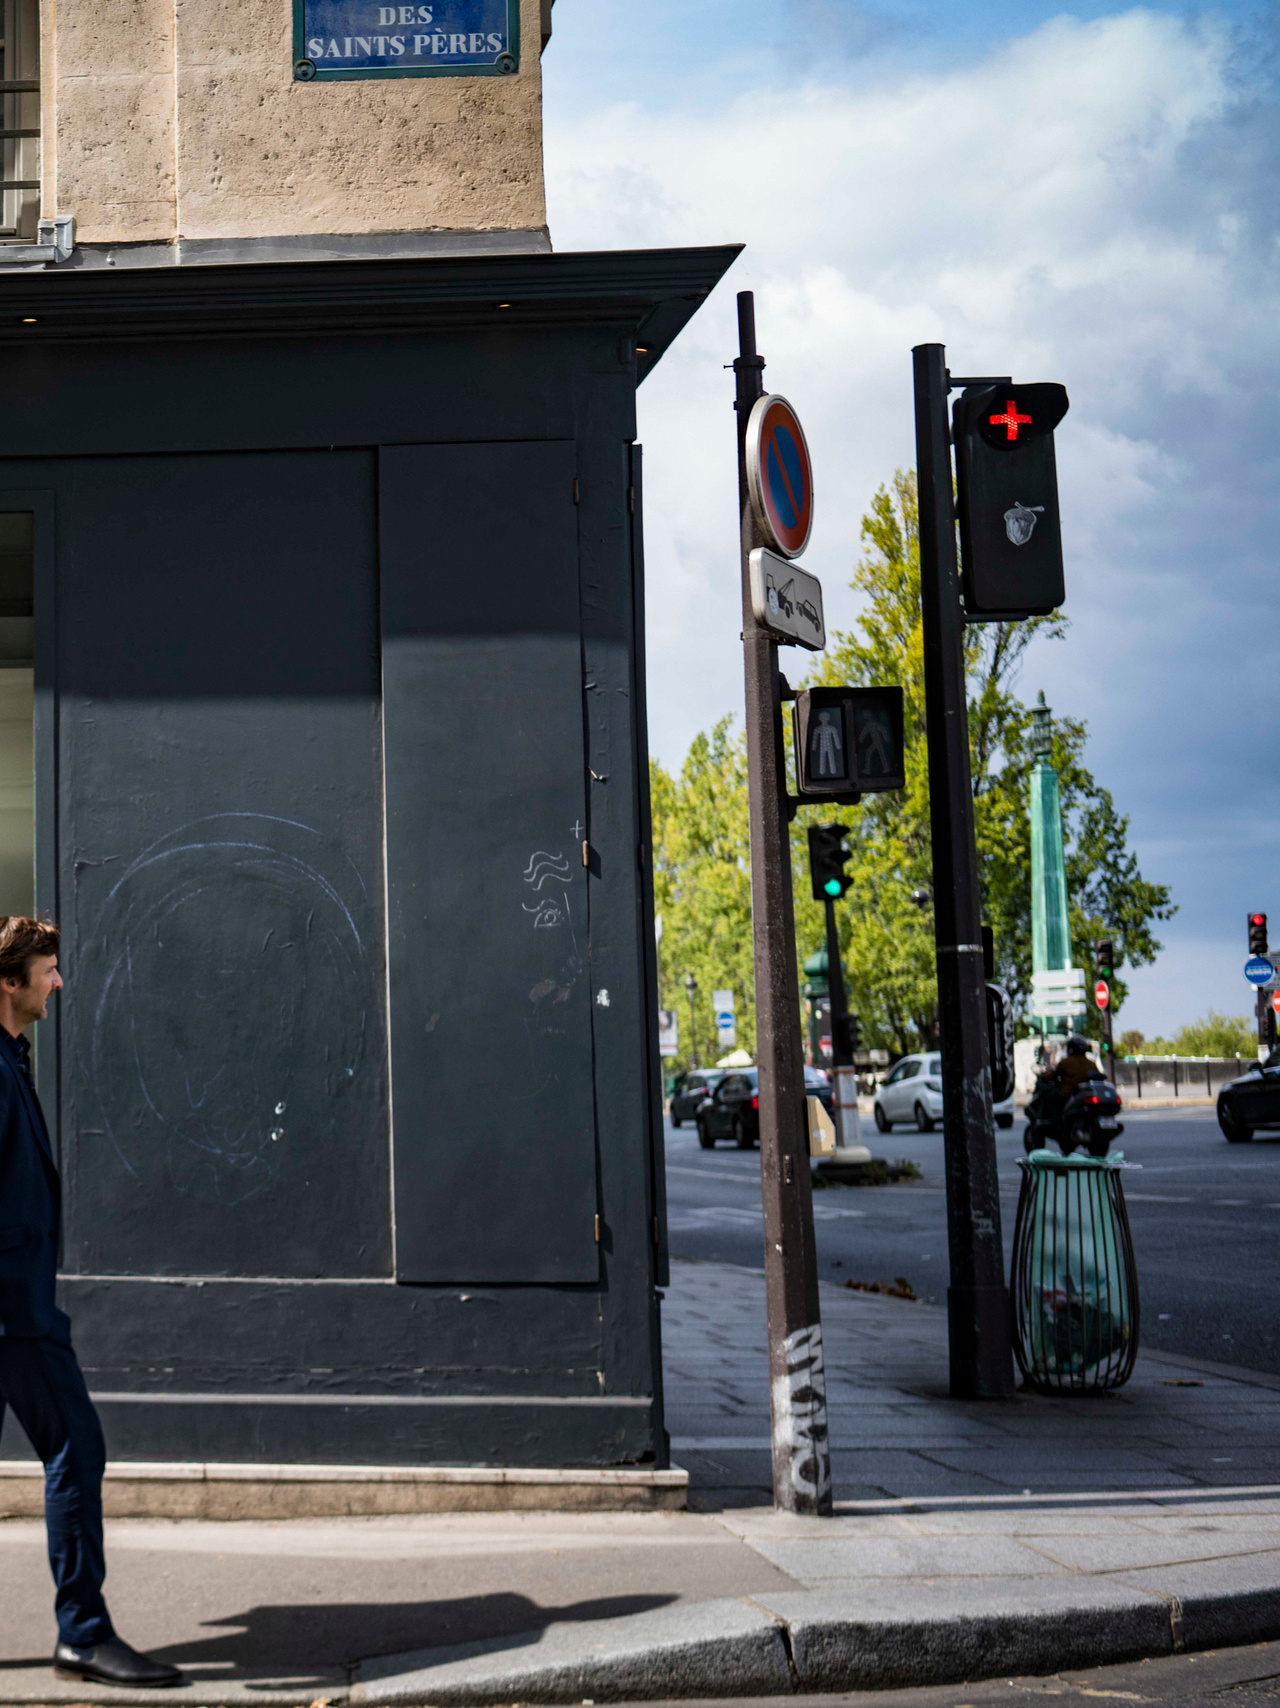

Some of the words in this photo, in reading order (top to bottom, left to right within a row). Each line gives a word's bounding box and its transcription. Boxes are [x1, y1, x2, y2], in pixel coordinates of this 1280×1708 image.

[378, 5, 434, 26] DES
[308, 35, 405, 59] SAINTS
[413, 28, 503, 55] PÈRES
